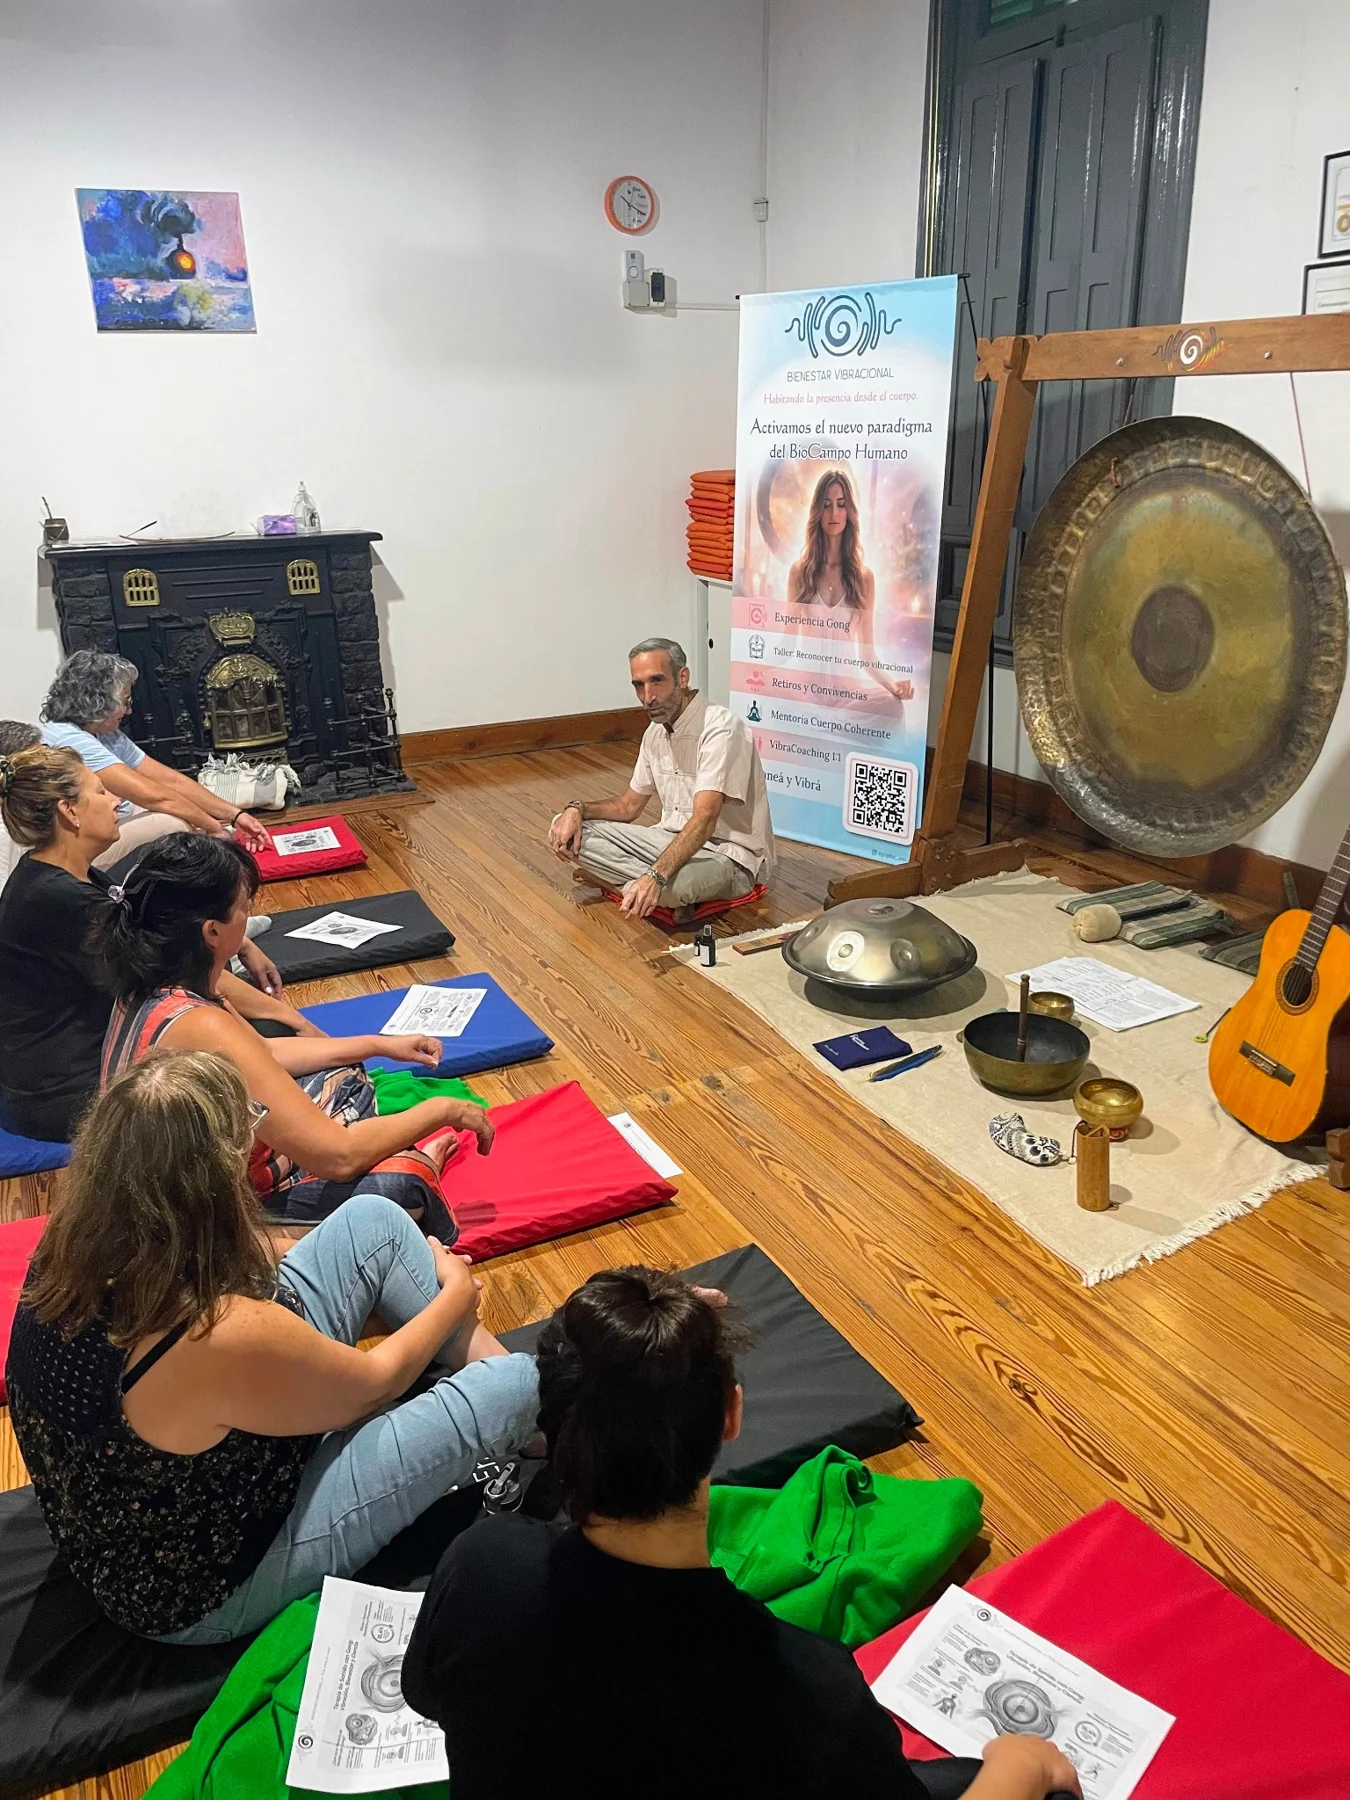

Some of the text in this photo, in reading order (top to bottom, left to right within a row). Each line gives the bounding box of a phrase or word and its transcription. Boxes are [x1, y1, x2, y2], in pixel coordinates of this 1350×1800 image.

[787, 367, 894, 382] BIENESTAR VIBRACIONAL
[764, 391, 919, 405] Habitando la presencia desde el cuerpo.
[750, 418, 932, 437] Activamos el nuevo paradigma
[770, 443, 908, 461] del BioCampo Humano
[775, 612, 850, 633] Experiencia Gong
[774, 647, 794, 657] Taller:
[797, 650, 833, 663] Reconocer
[844, 658, 869, 669] cuerpo
[871, 660, 913, 674] vibracional
[772, 678, 868, 701] Retiros y Convivencias
[771, 710, 891, 740] Mentoría Cuerpo Coherente
[770, 740, 841, 762] VibraCoaching 1:1
[764, 772, 821, 791] neá y Vibrá
